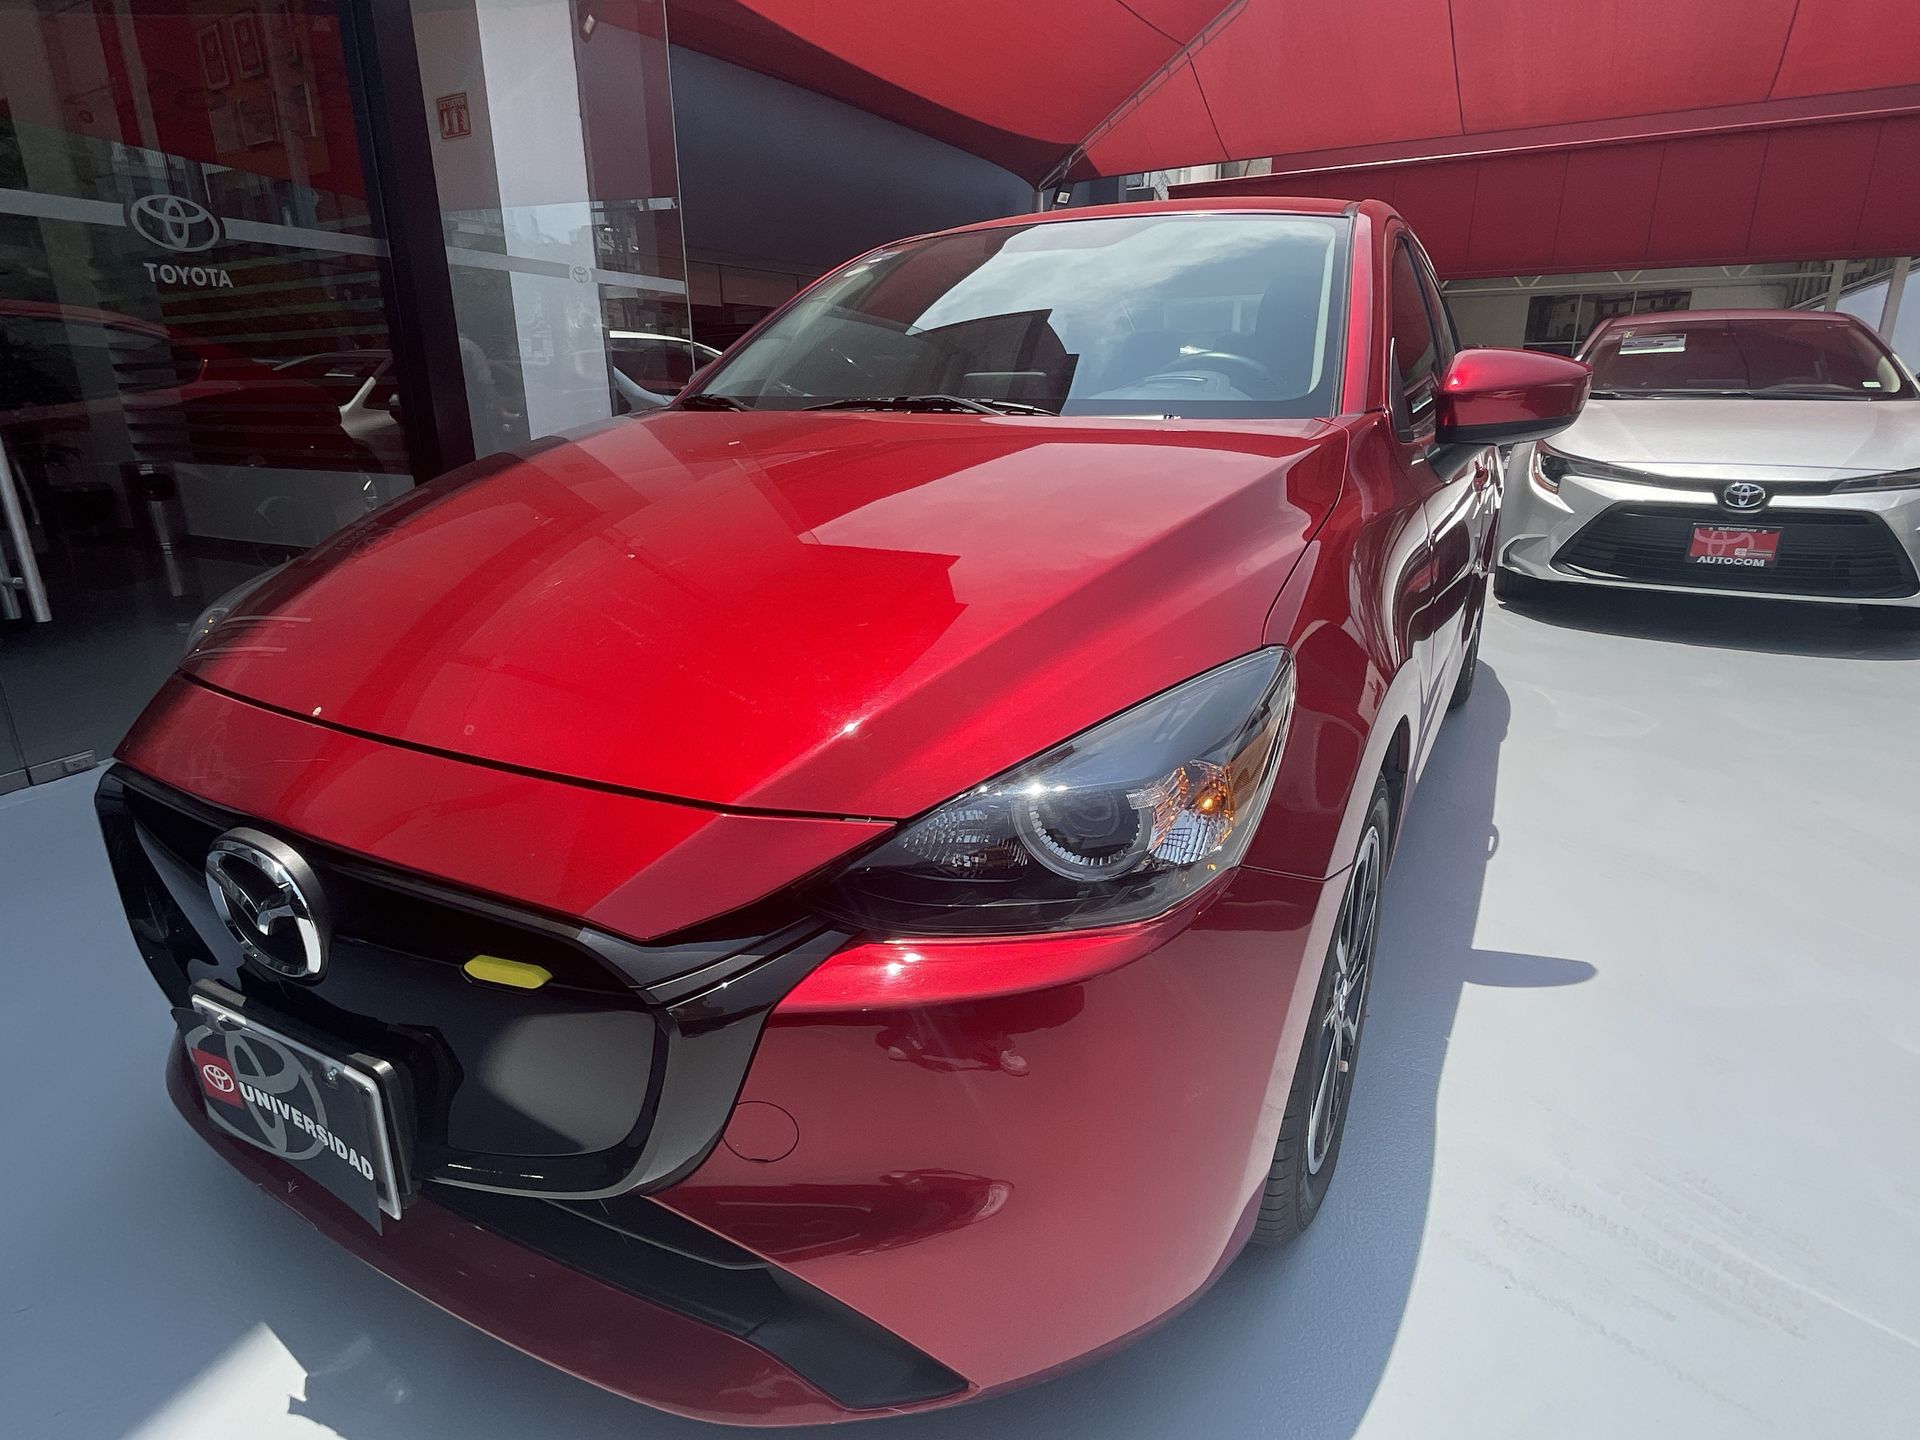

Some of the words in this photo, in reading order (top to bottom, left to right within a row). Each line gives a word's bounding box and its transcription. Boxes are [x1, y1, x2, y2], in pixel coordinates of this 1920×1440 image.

[143, 262, 234, 289] TOYOTA
[1696, 555, 1766, 567] AUTOCOM
[238, 1081, 375, 1181] UNIVERSIDAD
